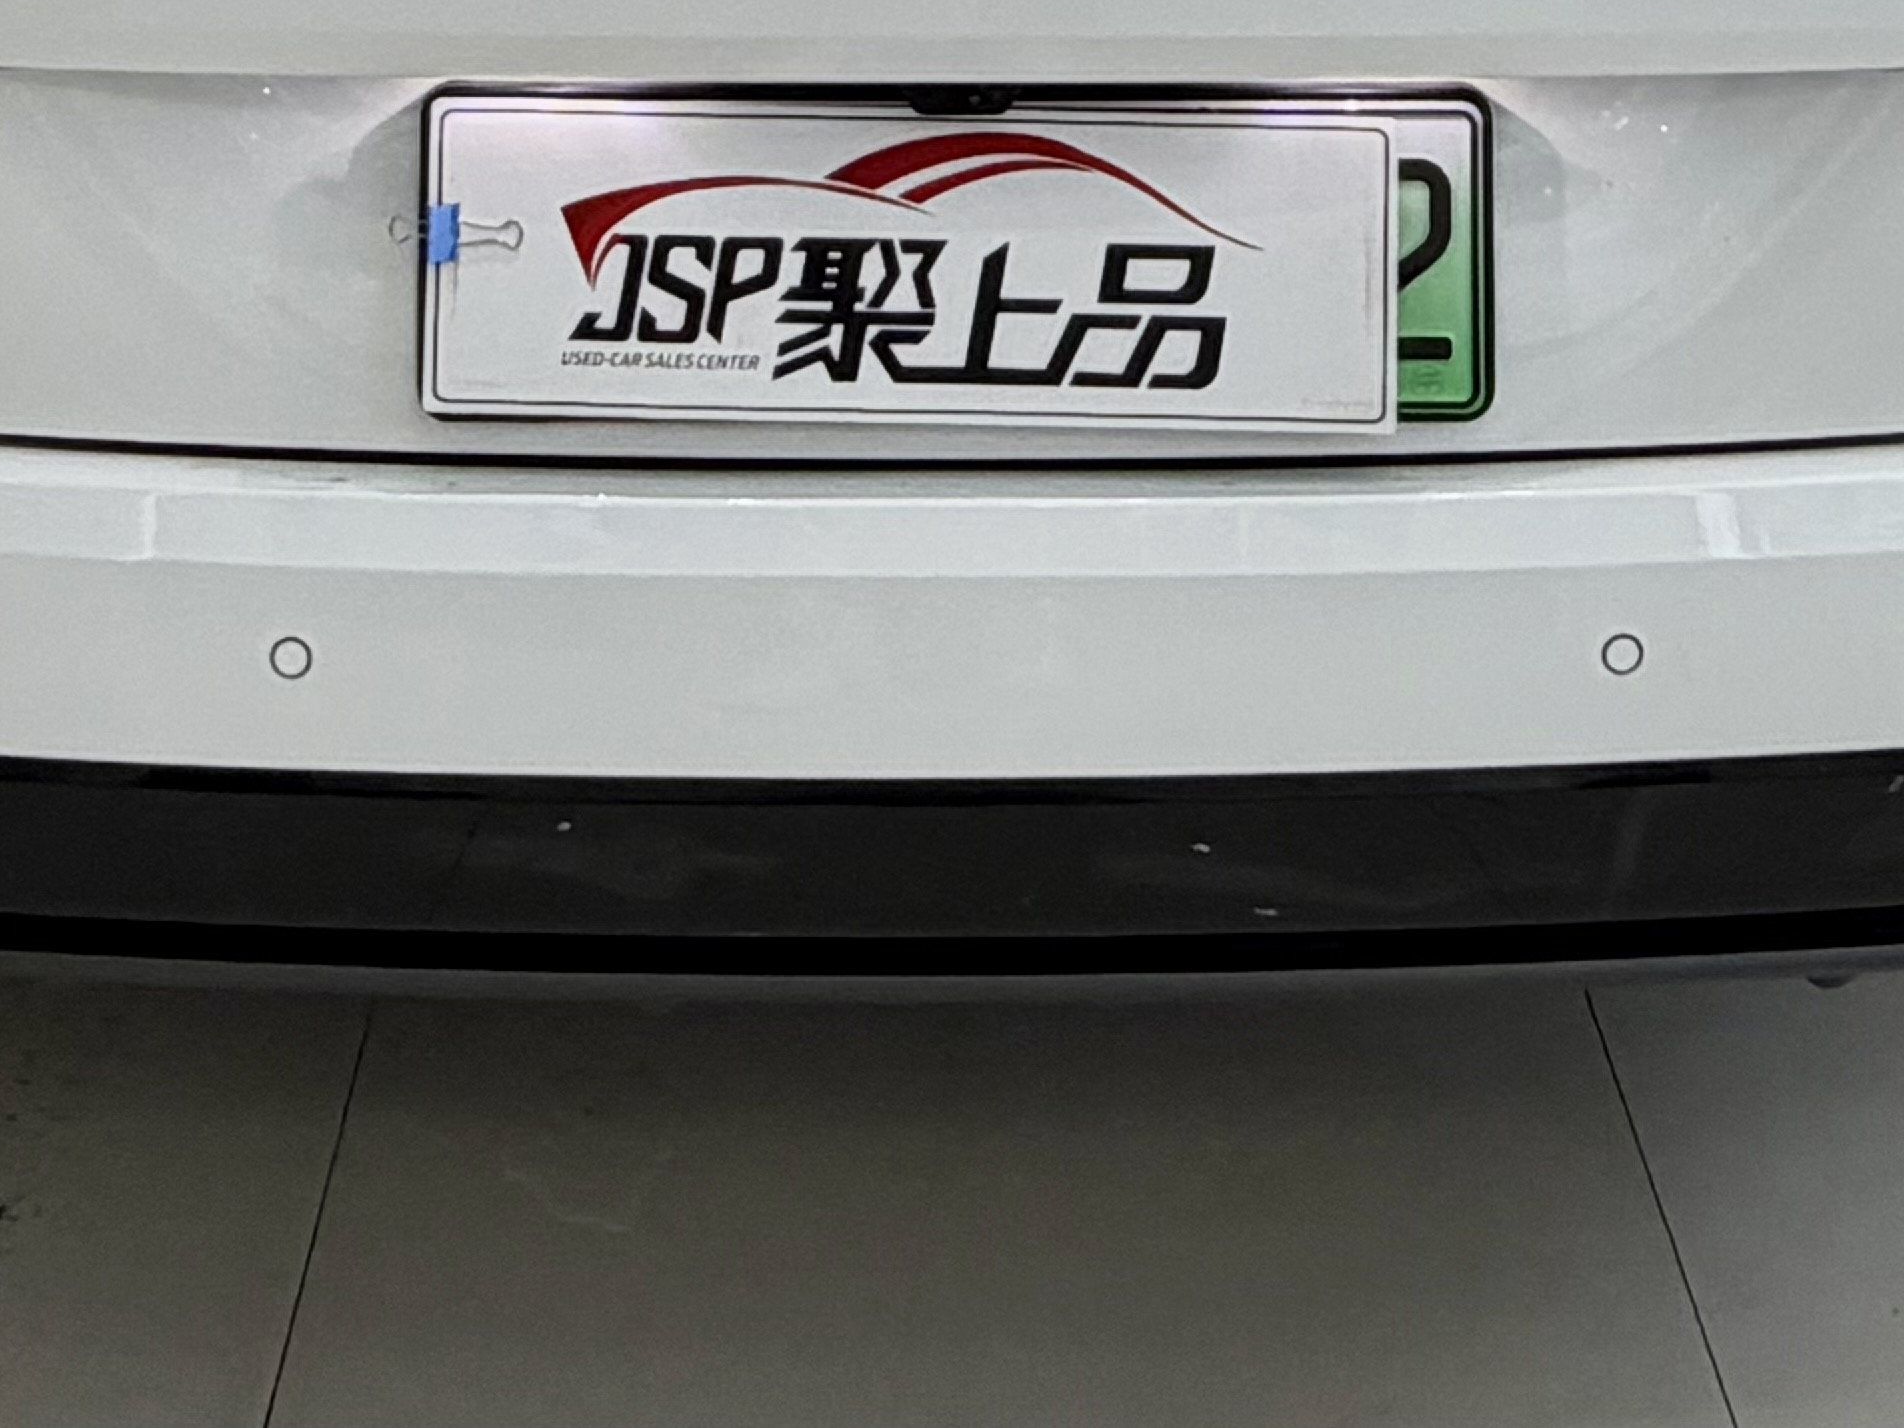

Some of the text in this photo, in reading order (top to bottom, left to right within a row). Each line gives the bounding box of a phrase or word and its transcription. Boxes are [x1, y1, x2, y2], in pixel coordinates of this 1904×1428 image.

[561, 350, 761, 370] USED-CAR SALES CENTER
